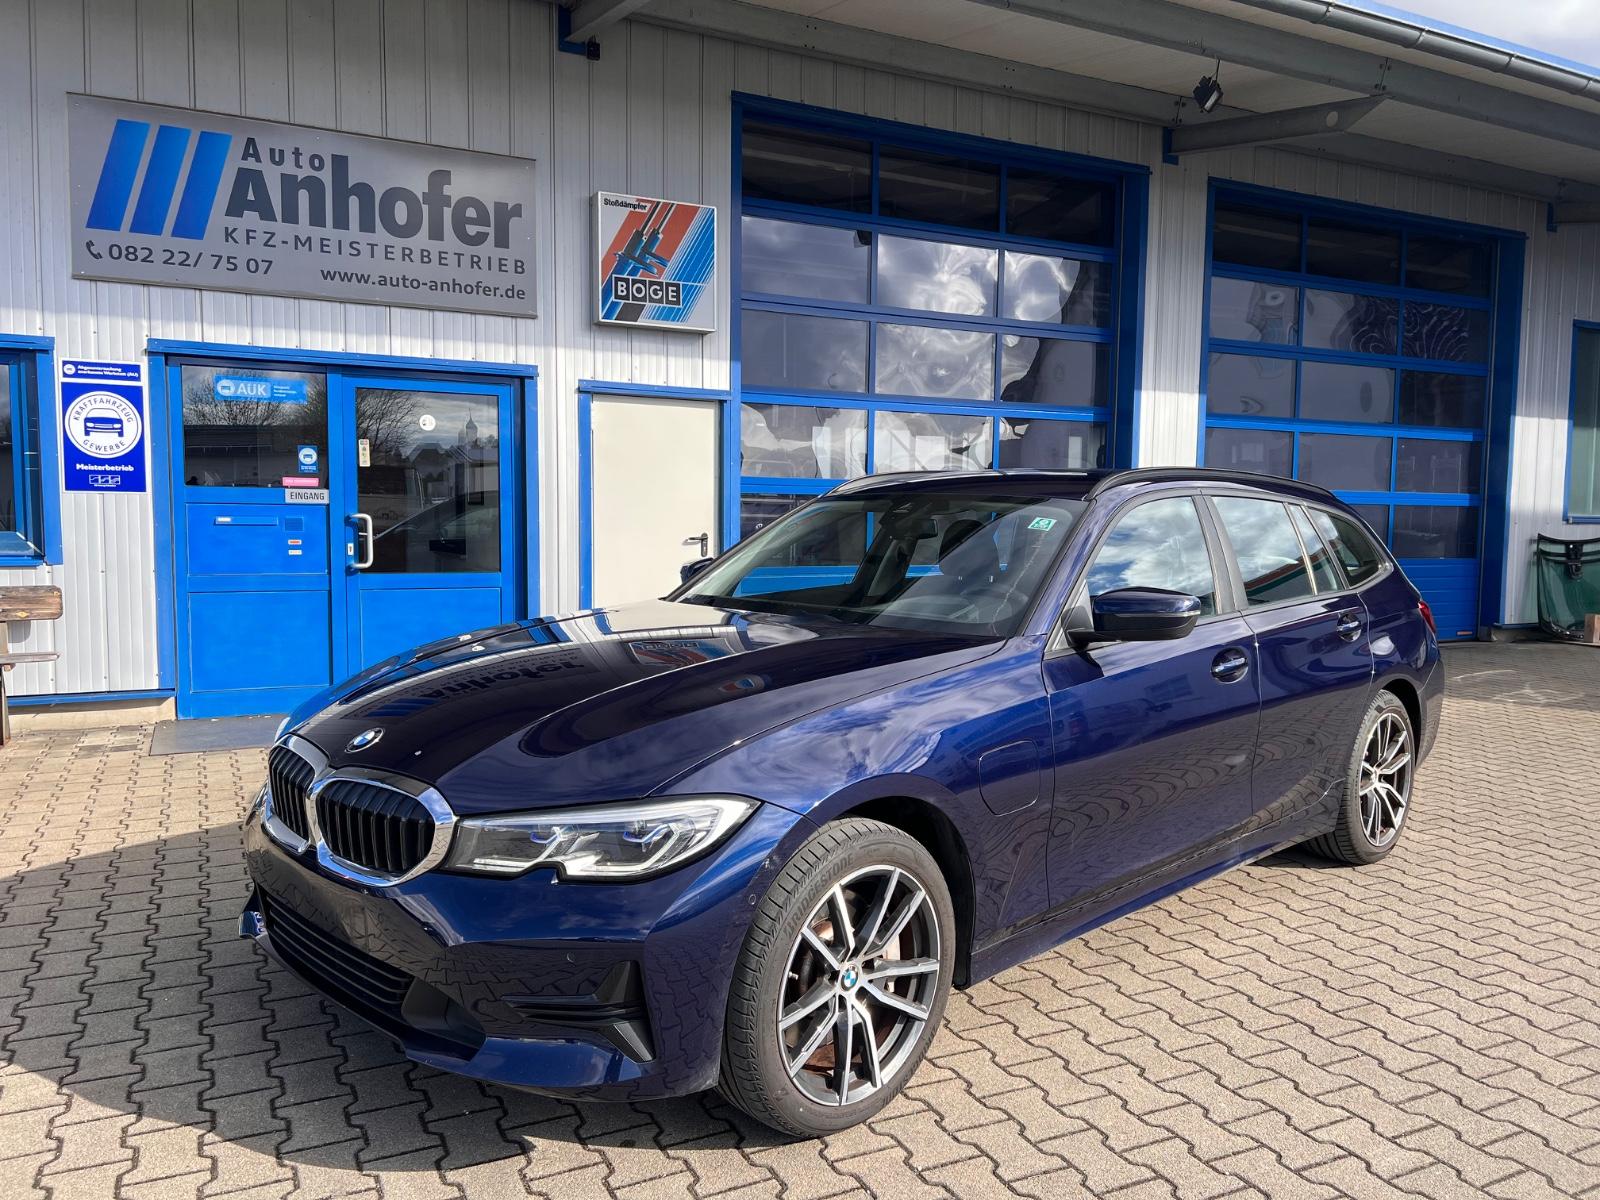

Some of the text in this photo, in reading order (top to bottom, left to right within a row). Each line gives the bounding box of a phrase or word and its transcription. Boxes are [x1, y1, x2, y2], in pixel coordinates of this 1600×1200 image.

[241, 137, 325, 172] Auto
[224, 154, 523, 249] Anhofer
[603, 197, 648, 211] Stoßdämpfer
[108, 243, 273, 275] 082 22/ 75 07
[224, 226, 526, 275] KFZ-MEISTERBETRIEB
[320, 268, 526, 300] www.auto-anhofer.de
[617, 281, 677, 301] BOGE
[73, 397, 134, 423] KRAFTFAHRZEUG
[83, 439, 126, 452] GEWERBE
[76, 463, 135, 472] Meisterbetrieb
[290, 491, 325, 501] EINGANG
